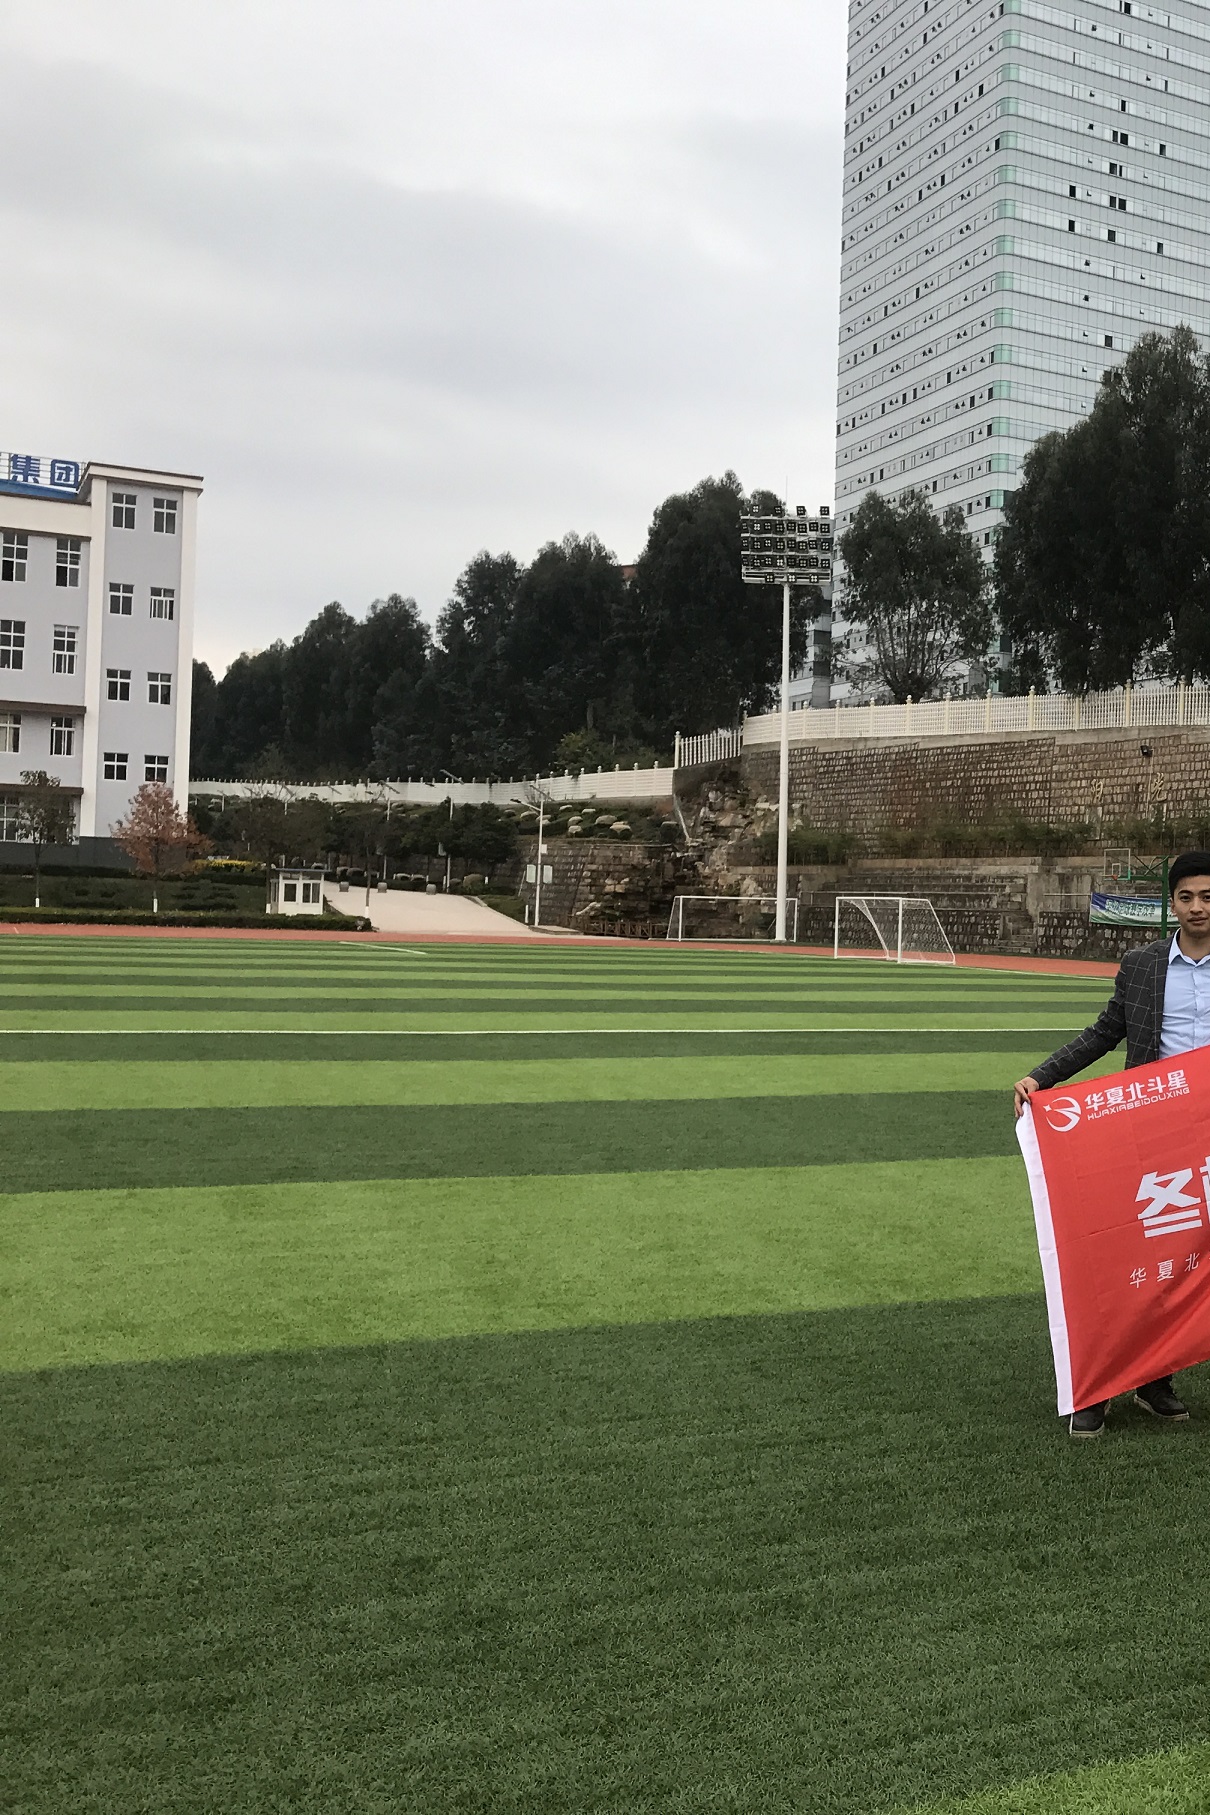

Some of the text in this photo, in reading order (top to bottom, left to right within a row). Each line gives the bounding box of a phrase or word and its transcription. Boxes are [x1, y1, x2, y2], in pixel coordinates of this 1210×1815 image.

[1084, 1069, 1189, 1112] 华夏北斗星
[1087, 1087, 1190, 1121] HUAXIABEIDOUXING
